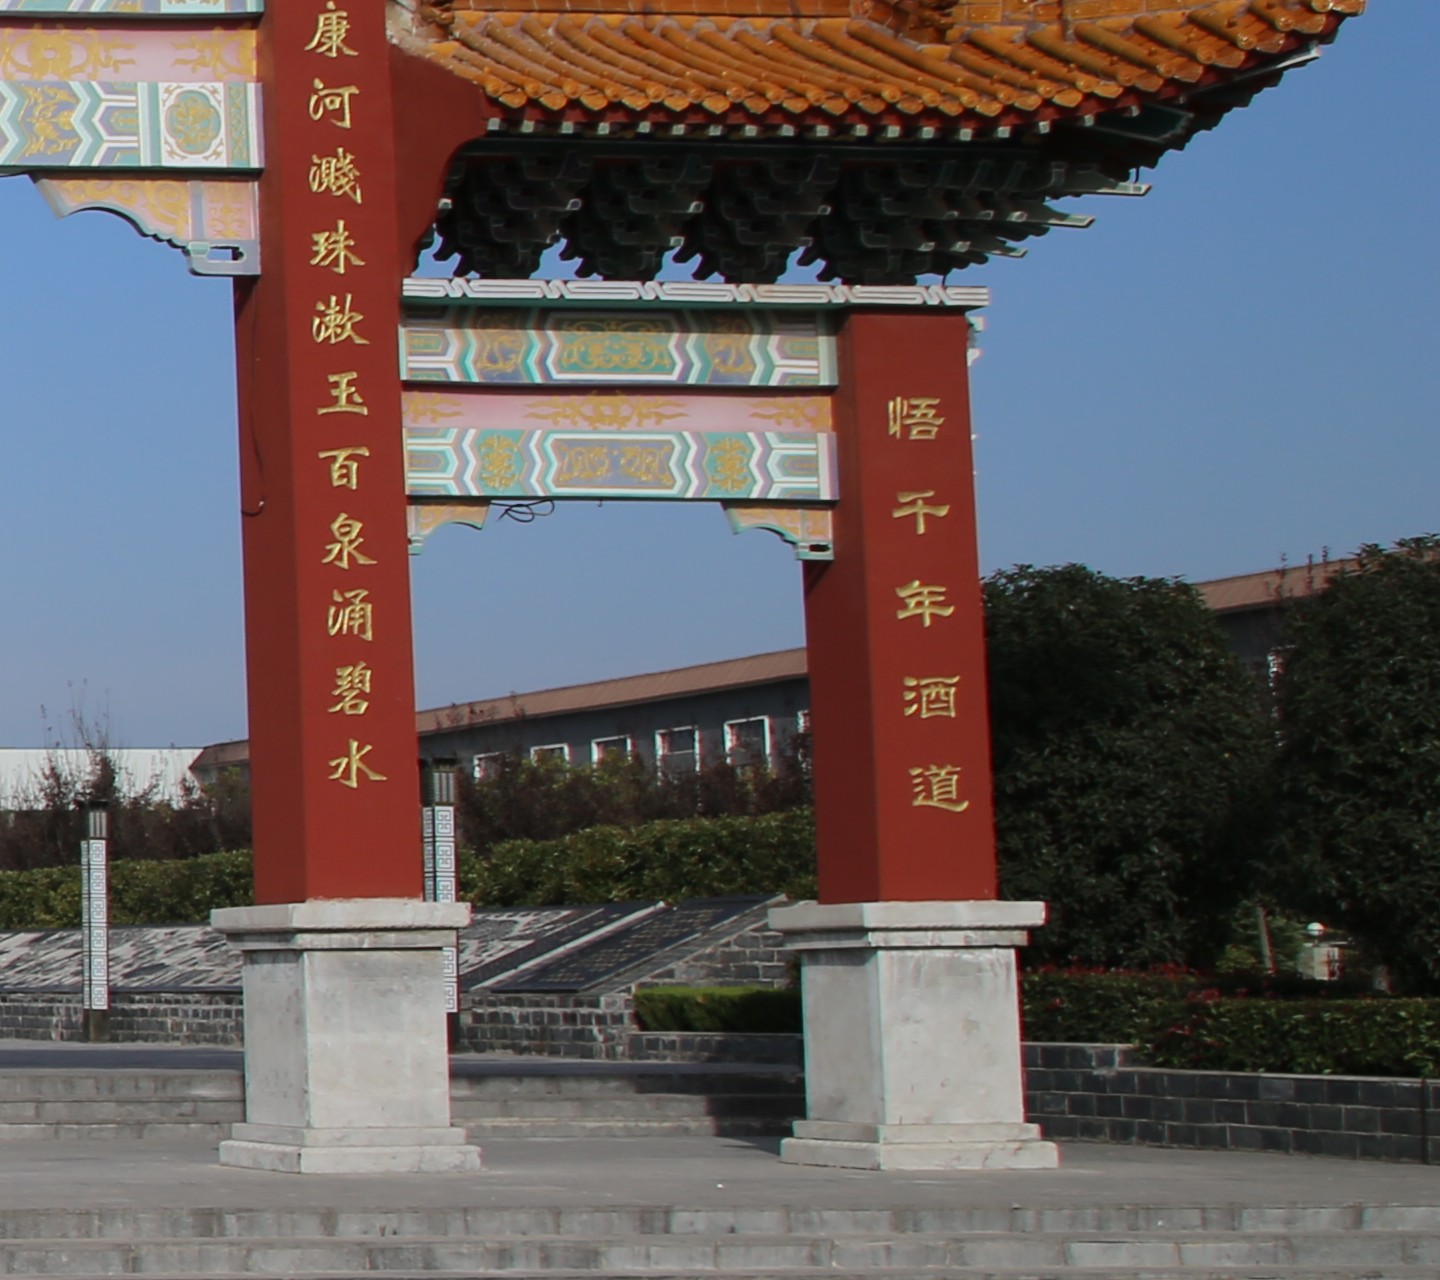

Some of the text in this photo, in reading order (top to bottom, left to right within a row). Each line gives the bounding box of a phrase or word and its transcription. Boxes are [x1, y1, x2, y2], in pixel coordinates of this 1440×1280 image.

[887, 396, 968, 813] 悟千年酒道
